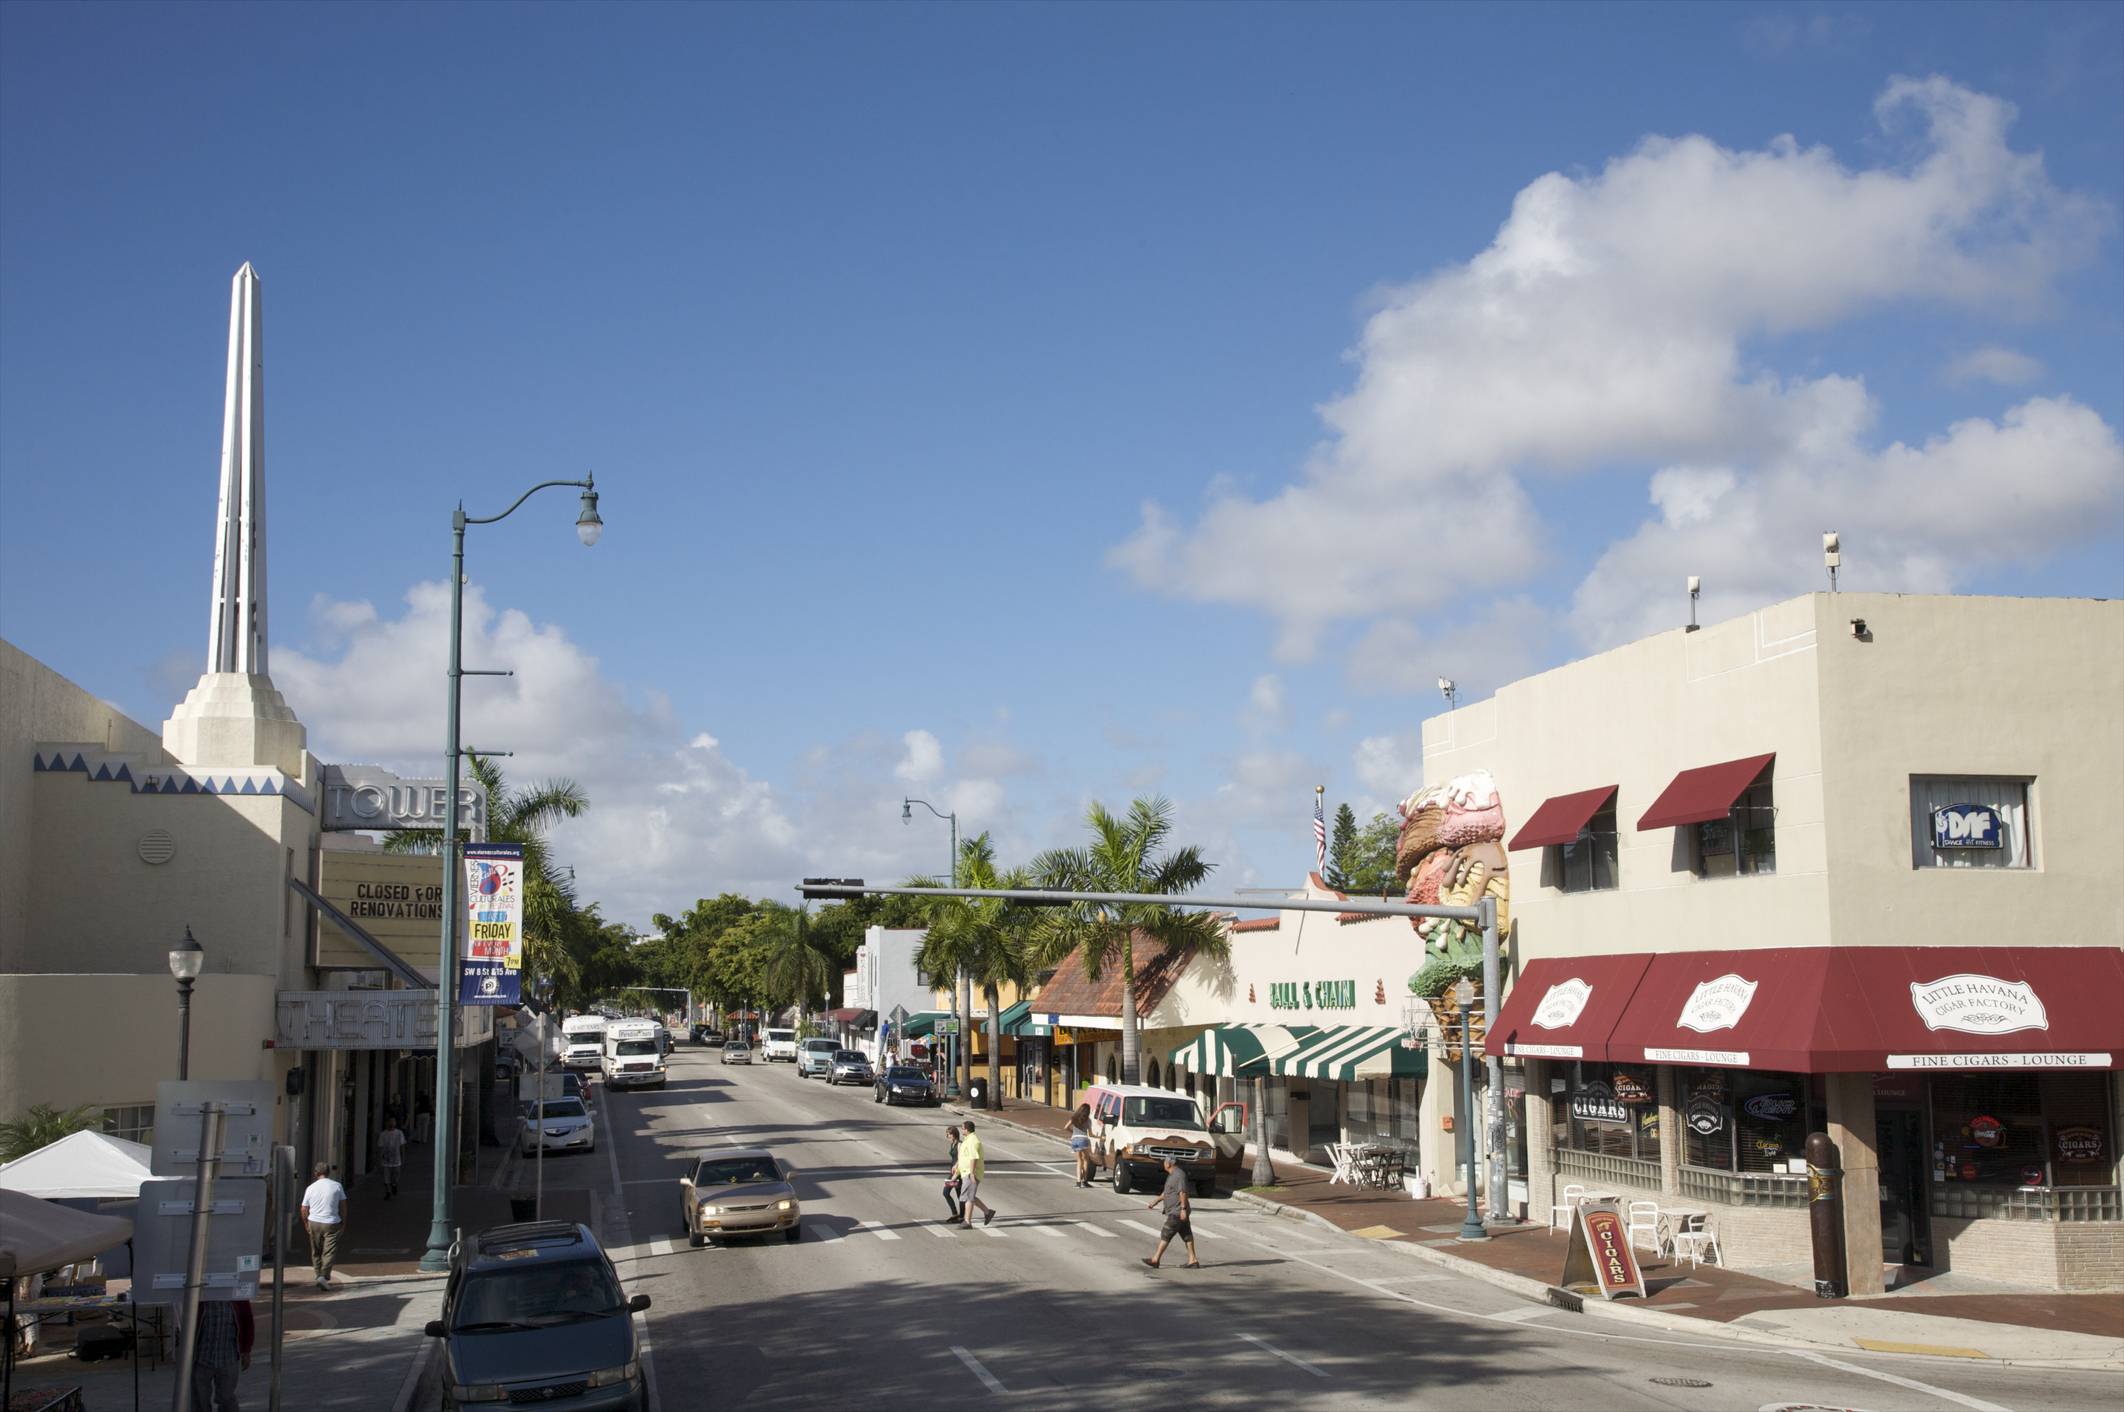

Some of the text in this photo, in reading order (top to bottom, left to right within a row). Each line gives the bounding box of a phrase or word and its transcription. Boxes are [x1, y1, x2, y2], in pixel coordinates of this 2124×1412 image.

[328, 785, 476, 820] TOWER
[357, 884, 443, 901] CLOSED FOR
[351, 901, 443, 918] RENOVATIONS
[474, 923, 511, 939] FRIDAY
[464, 967, 475, 976] SW
[477, 968, 482, 976] 8
[483, 968, 490, 976] St
[505, 968, 517, 976] Ave
[1270, 982, 1299, 1009] BALL
[1315, 980, 1355, 1009] CHAIN
[1695, 984, 1722, 1004] LITTLE
[1922, 983, 2029, 1005] LITTLE HAVANA
[1935, 998, 2026, 1016] CIGAR FACTORY
[1655, 1050, 1672, 1059] FINE
[1672, 1051, 1700, 1061] CIGARS
[1705, 1053, 1738, 1063] LOUNGE
[1912, 1056, 1948, 1067] FINE
[1953, 1055, 2009, 1066] CIGARS
[2023, 1055, 2087, 1066] LOUNGE
[1574, 1097, 1625, 1119] CIGARS
[2062, 1140, 2098, 1149] CIGARS
[1600, 1231, 1625, 1283] CIGARS
